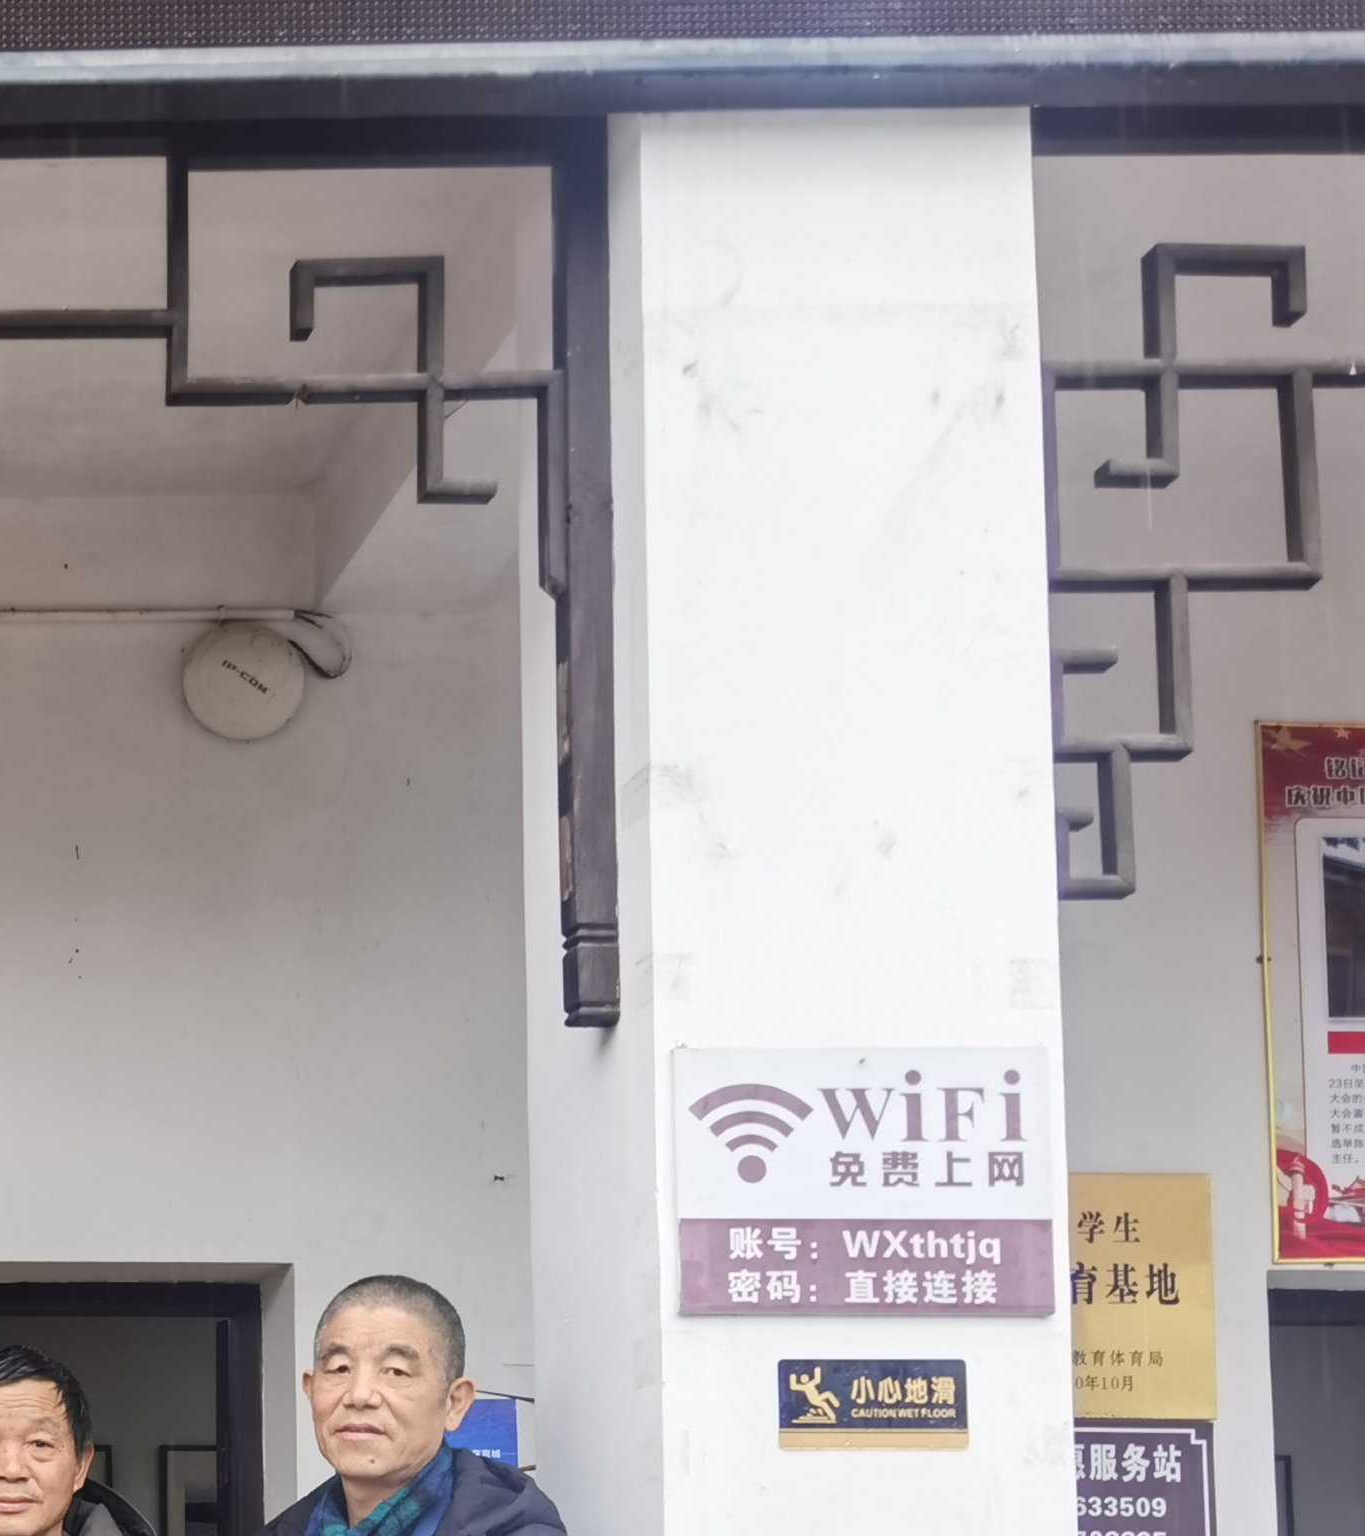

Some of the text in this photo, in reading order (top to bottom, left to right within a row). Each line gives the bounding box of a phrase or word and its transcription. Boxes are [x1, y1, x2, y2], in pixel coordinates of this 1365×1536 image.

[1285, 785, 1365, 808] 庆祝中
[817, 1069, 1028, 1142] WiFi
[829, 1151, 1025, 1187] 免费上网
[1077, 1210, 1141, 1244] 学生
[1070, 1261, 1180, 1306] 育基地
[851, 1376, 957, 1405] 小心地滑
[851, 1408, 957, 1419] CAUTION WET FLOOR
[1076, 1496, 1167, 1518] 633509
